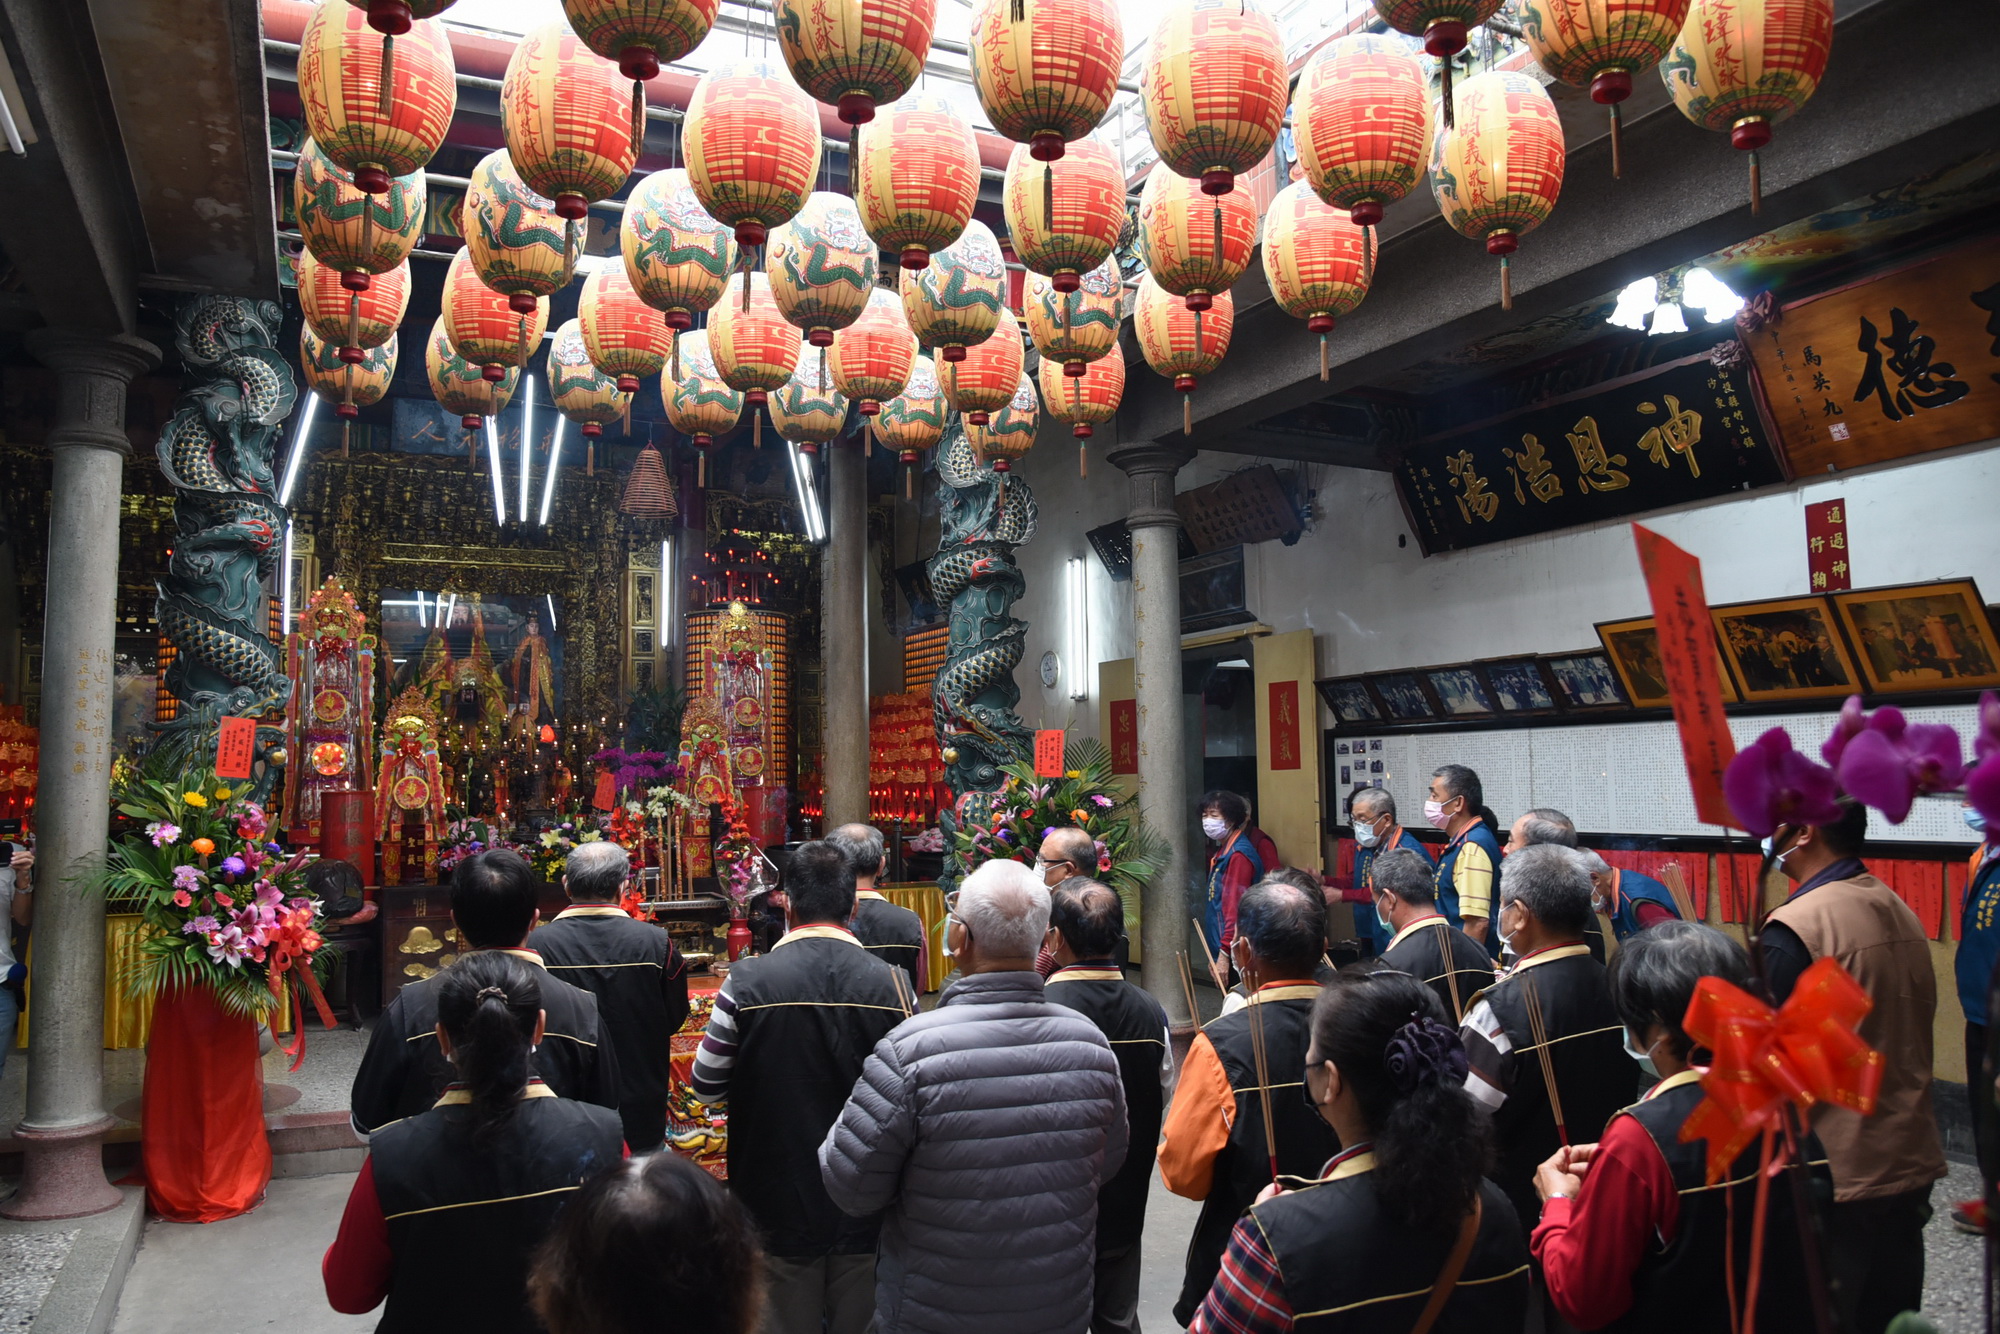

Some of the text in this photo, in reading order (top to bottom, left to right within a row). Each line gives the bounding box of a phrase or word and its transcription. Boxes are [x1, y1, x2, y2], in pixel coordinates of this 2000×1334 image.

[1459, 90, 1491, 206] 陳明義敬獻
[1803, 345, 1844, 418] 馬英九
[1826, 506, 1848, 591] 通過神
